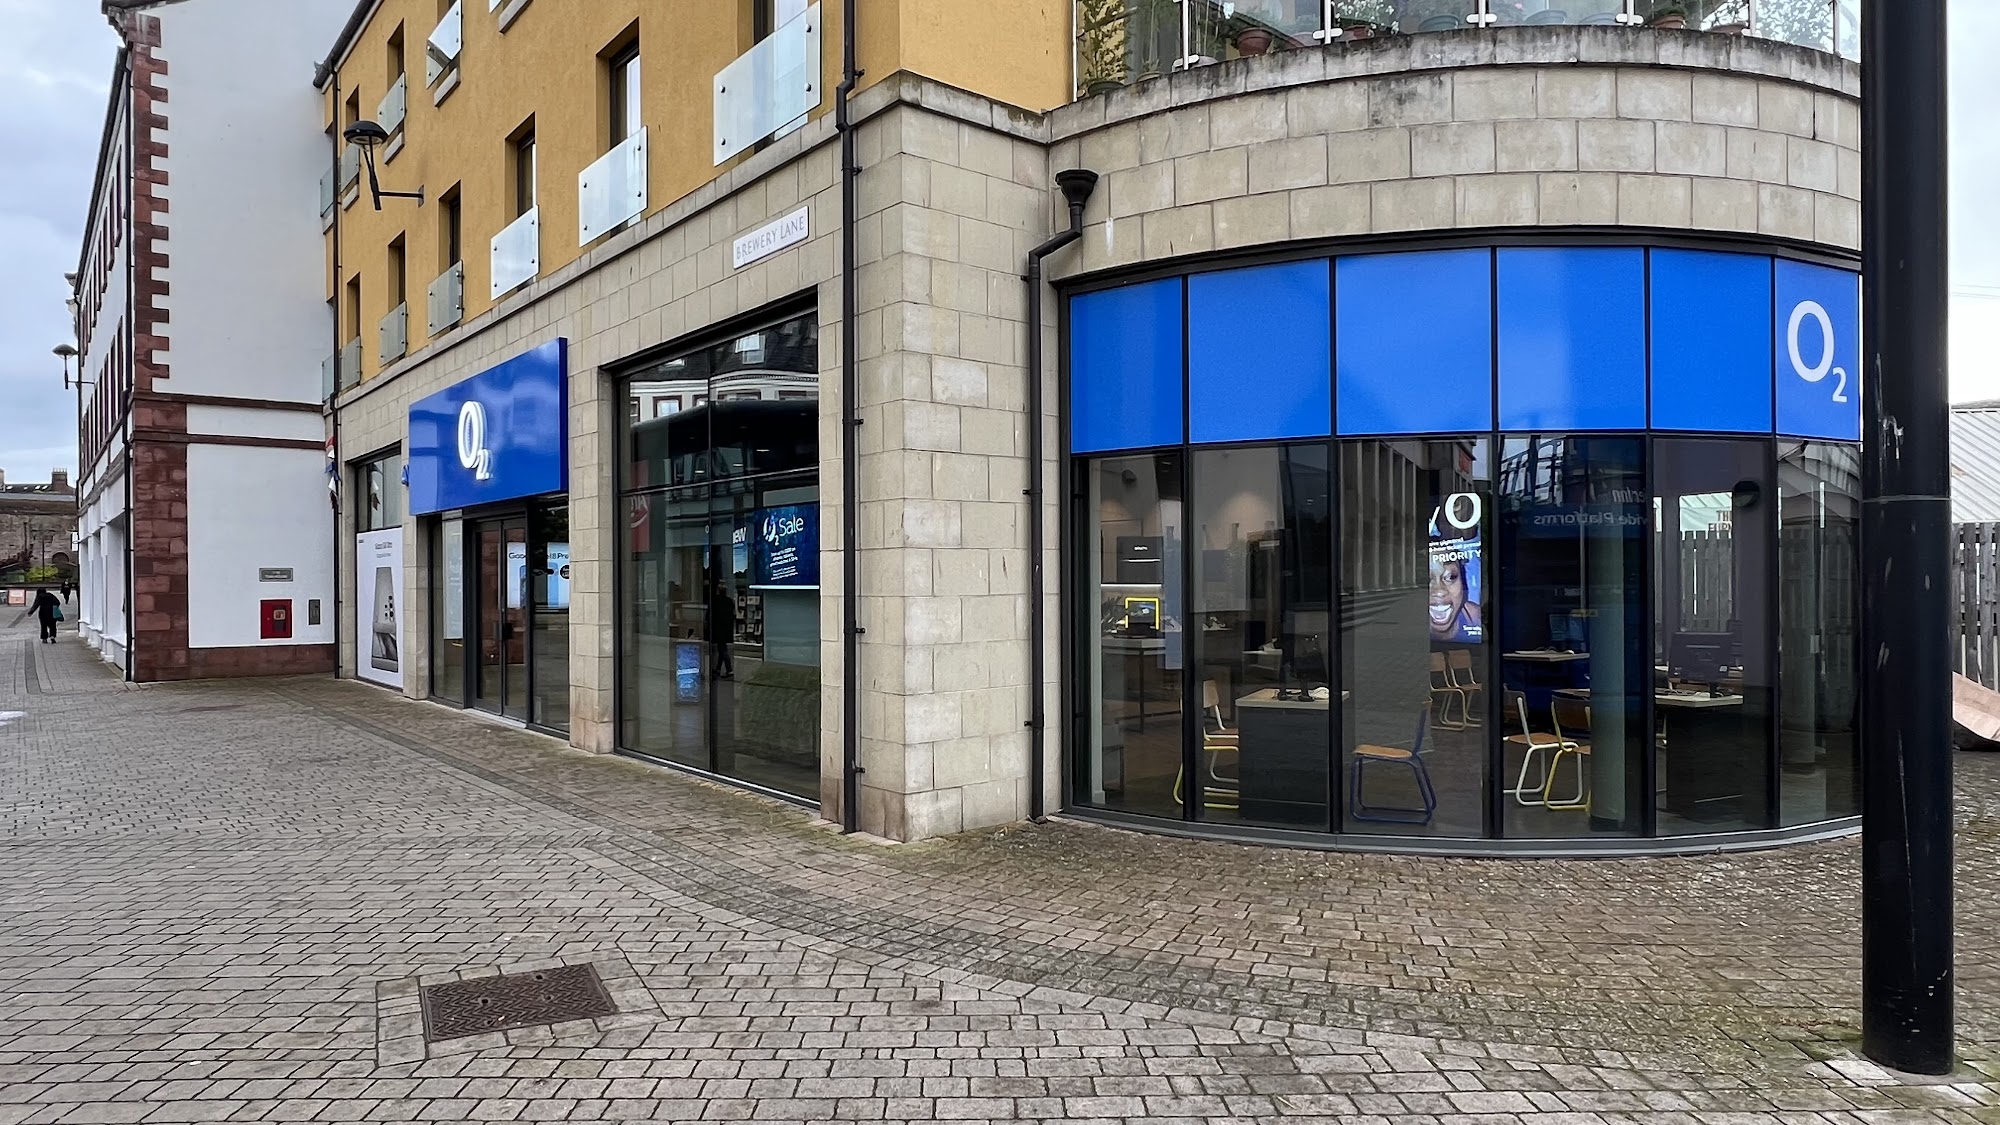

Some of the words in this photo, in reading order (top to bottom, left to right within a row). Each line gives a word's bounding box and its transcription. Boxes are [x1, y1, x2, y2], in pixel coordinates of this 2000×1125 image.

[736, 228, 778, 260] BREWERY
[780, 215, 805, 239] LANE
[1787, 300, 1848, 403] O2
[458, 400, 490, 481] O2
[779, 514, 804, 537] Sale
[1432, 549, 1482, 563] PRIORITY
